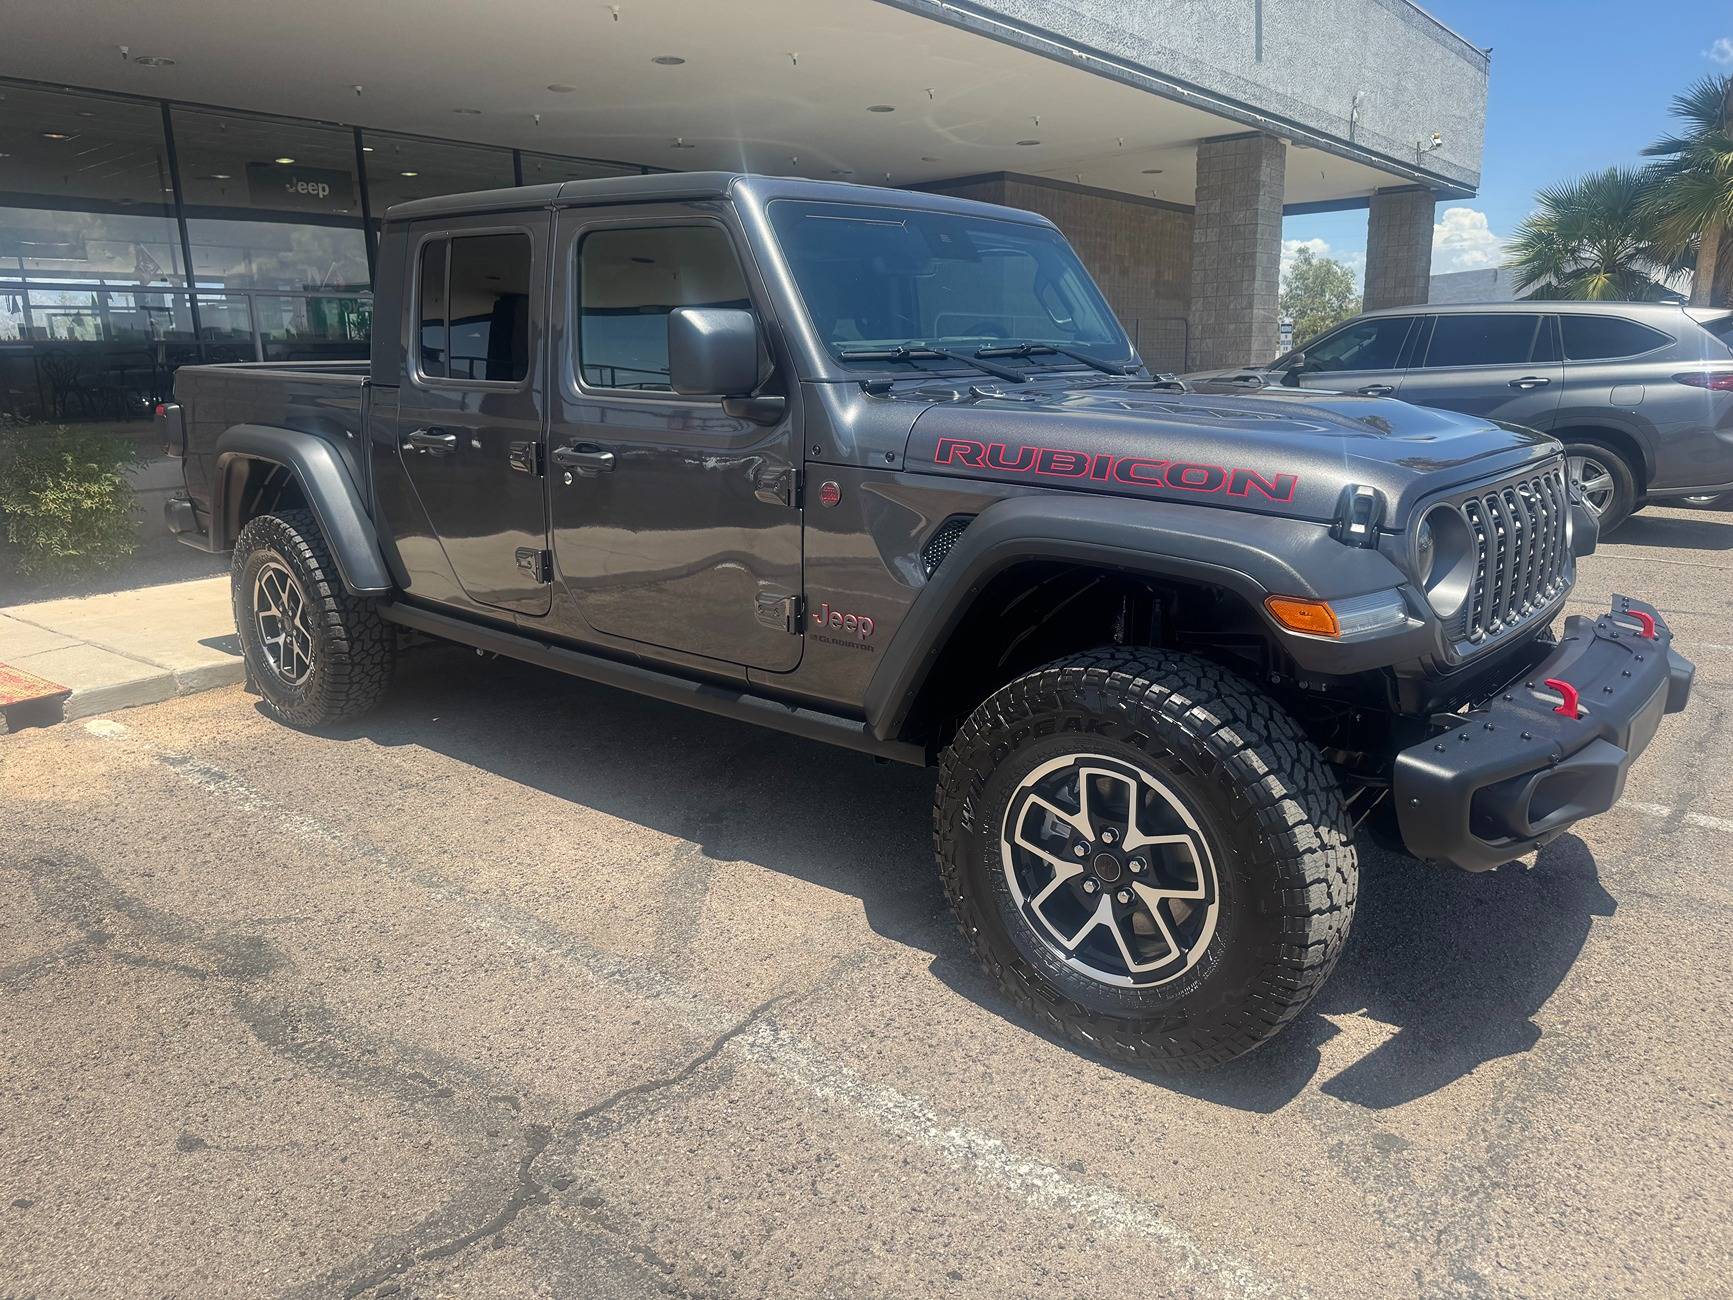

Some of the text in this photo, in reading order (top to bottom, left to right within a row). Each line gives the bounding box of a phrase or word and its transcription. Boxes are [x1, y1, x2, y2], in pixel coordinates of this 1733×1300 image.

[285, 176, 329, 198] Jeep
[935, 438, 1298, 502] RUBICON
[812, 603, 876, 640] Jeep
